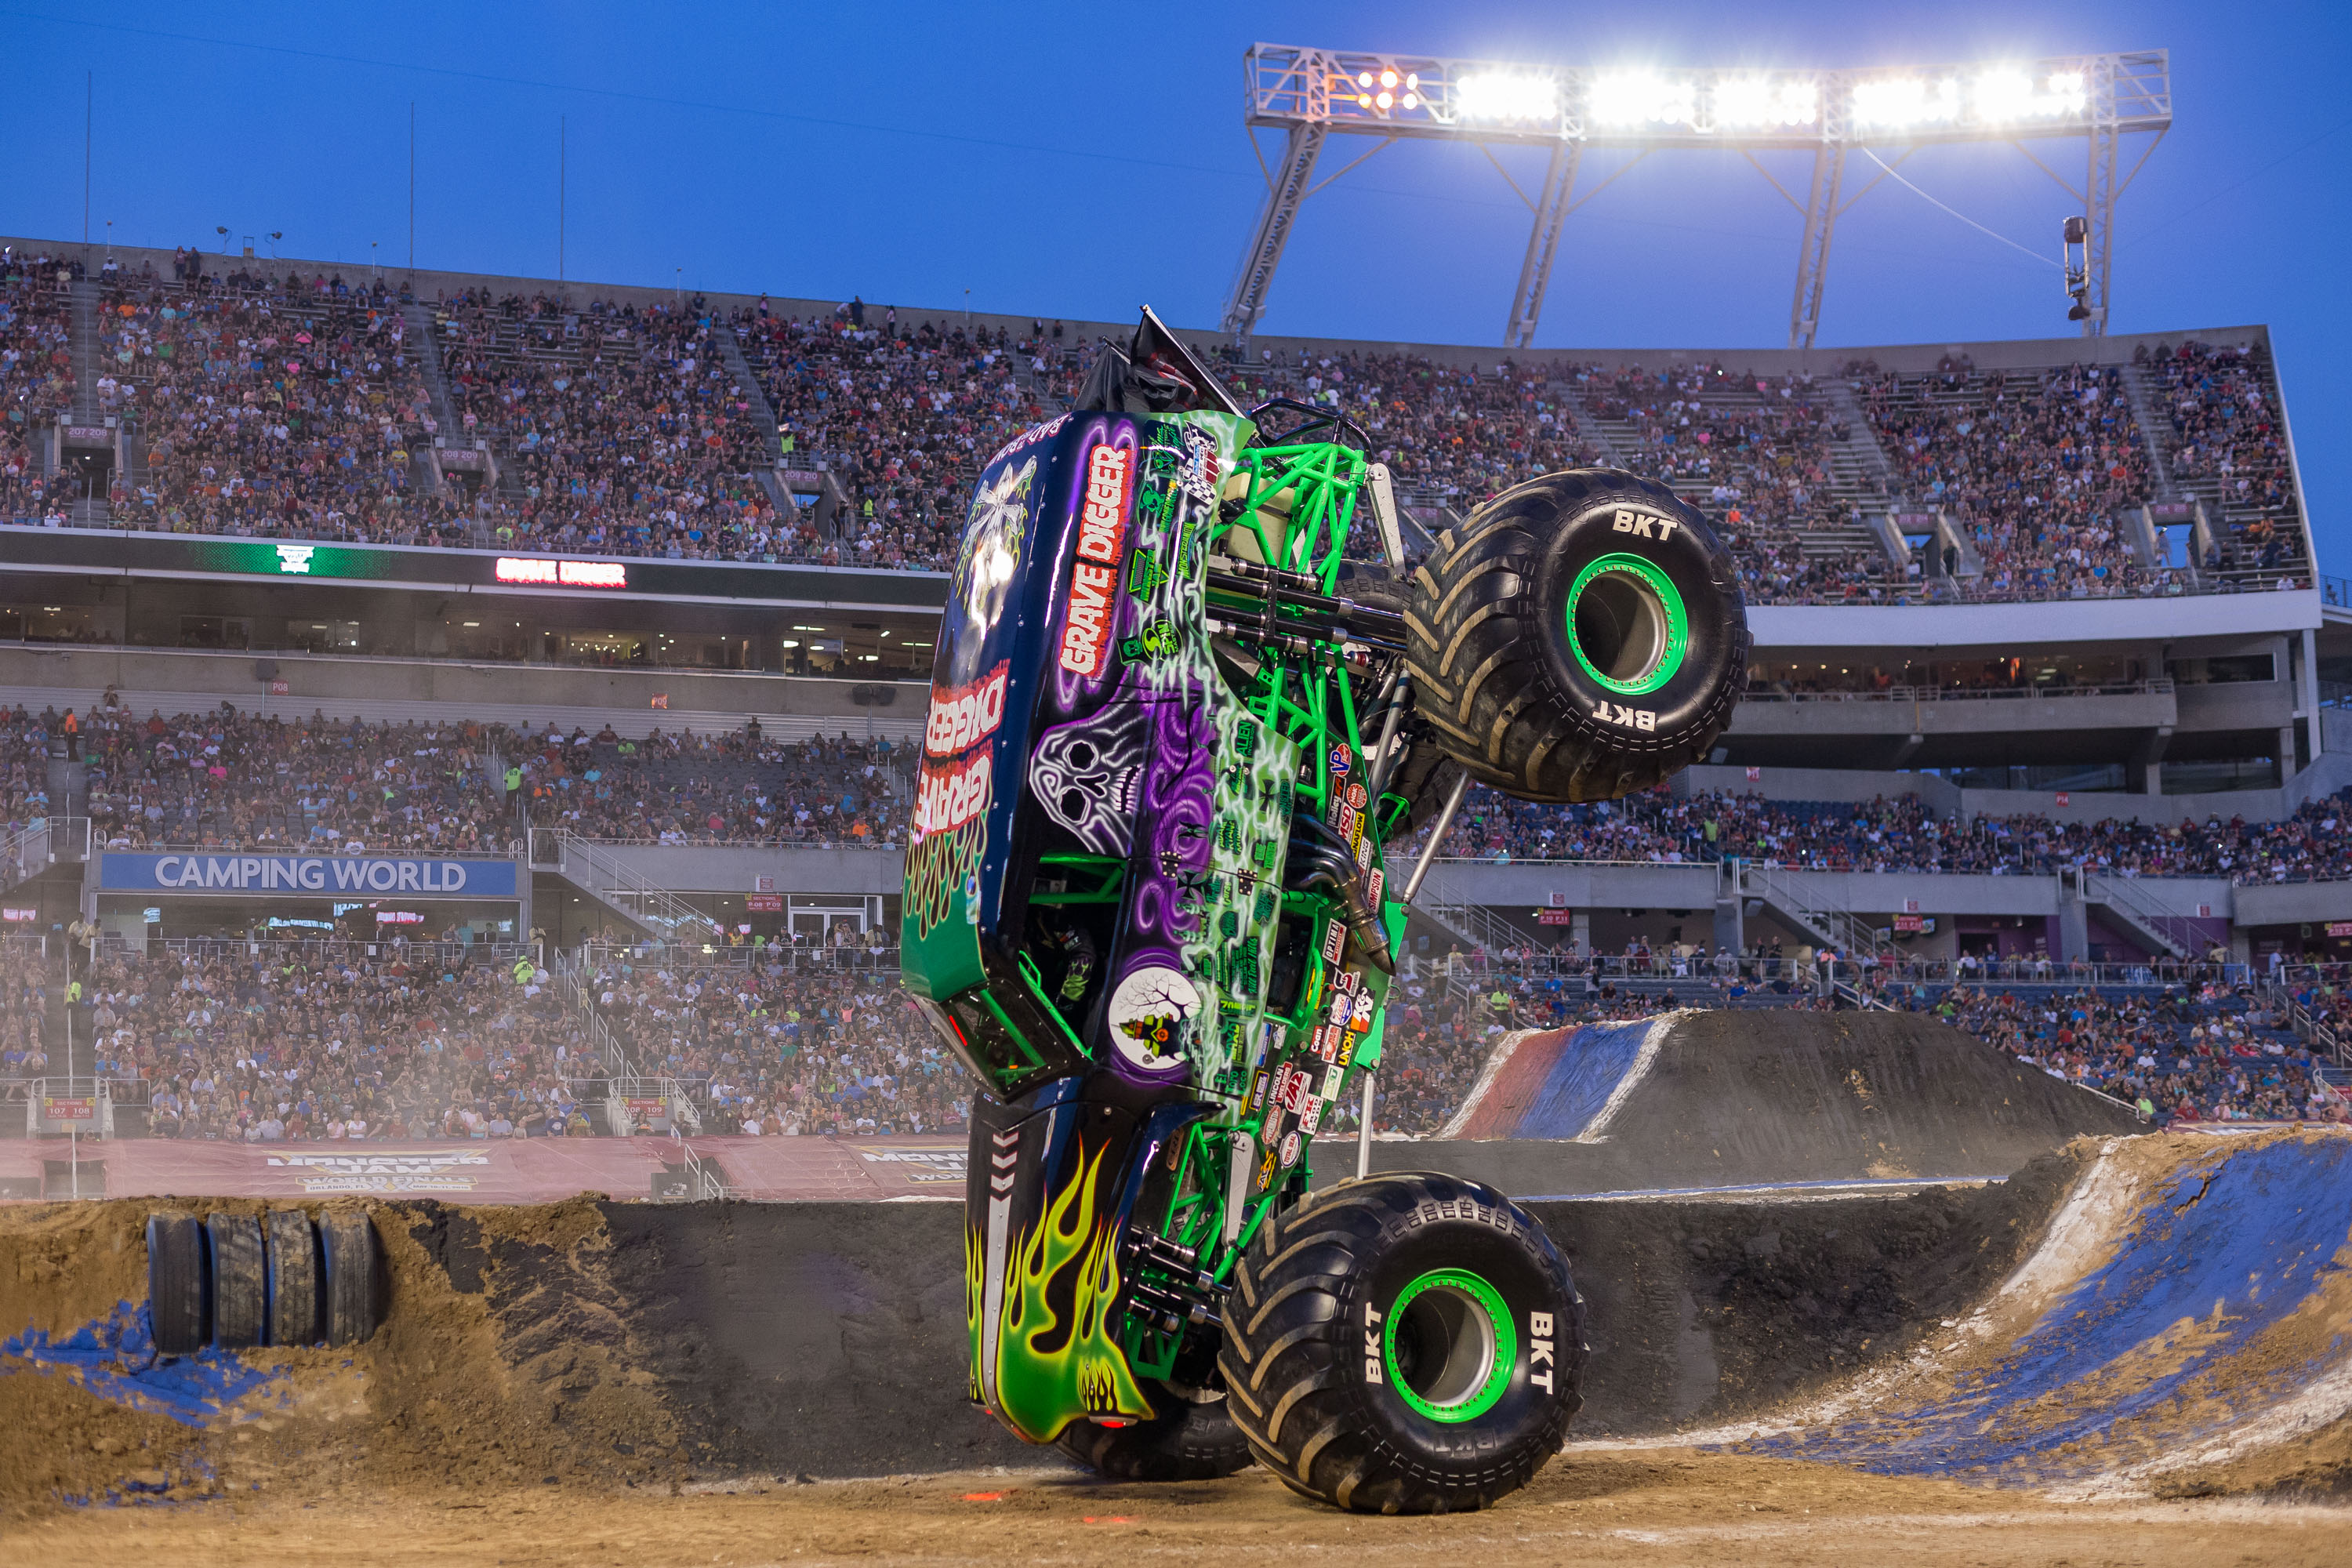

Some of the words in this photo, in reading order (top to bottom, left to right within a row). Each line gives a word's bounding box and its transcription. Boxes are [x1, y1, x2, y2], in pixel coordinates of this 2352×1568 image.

[69, 427, 86, 436] 207
[89, 428, 107, 437] 208
[441, 450, 459, 459] 208
[1080, 445, 1126, 561] DIGGER
[1612, 509, 1678, 542] BKT
[1141, 550, 1156, 601] MONSTER
[1151, 562, 1163, 588] JAM
[1060, 563, 1110, 675] GRAVE
[1157, 622, 1175, 655] SPIN
[273, 682, 289, 691] P08
[653, 696, 667, 706] P09
[927, 674, 1005, 753] DIGGER
[1592, 700, 1657, 732] BKT
[1236, 720, 1251, 757] ALIEN
[1329, 752, 1350, 772] VP
[915, 755, 990, 832] GRAVE
[1349, 786, 1358, 804] NGK
[1328, 795, 1342, 826] Holley
[1339, 806, 1352, 840] MSD
[1359, 840, 1369, 867] KING
[155, 857, 325, 890] CAMPING
[332, 861, 467, 892] WORLD
[1368, 872, 1381, 910] SIMPSON
[1247, 938, 1258, 958] Hills
[1325, 924, 1339, 958] OPTIMA
[1335, 996, 1345, 1021] LUCAS
[1352, 987, 1374, 1022] K&N
[1225, 1022, 1240, 1061] MAX-D
[1311, 1028, 1323, 1053] Coan
[1338, 1030, 1355, 1066] UNOH
[1214, 1073, 1227, 1084] El
[1225, 1070, 1239, 1094] Toro
[1236, 1070, 1248, 1095] Loco
[1269, 1068, 1284, 1105] LINCOLN
[1277, 1066, 1290, 1099] WELDERS
[1285, 1073, 1304, 1110] JAZ
[1301, 1096, 1315, 1127] FK
[1309, 1099, 1319, 1123] ROD
[1312, 1099, 1323, 1132] ENDS
[1283, 1149, 1293, 1163] TOTAL
[1287, 1135, 1297, 1148] SEAL
[267, 1157, 491, 1166] MONSTER
[329, 1165, 433, 1174] JAM
[303, 1176, 383, 1185] WORLD
[1258, 1168, 1270, 1192] PAC
[1365, 1301, 1383, 1385] BKT
[1530, 1311, 1554, 1396] BKT
